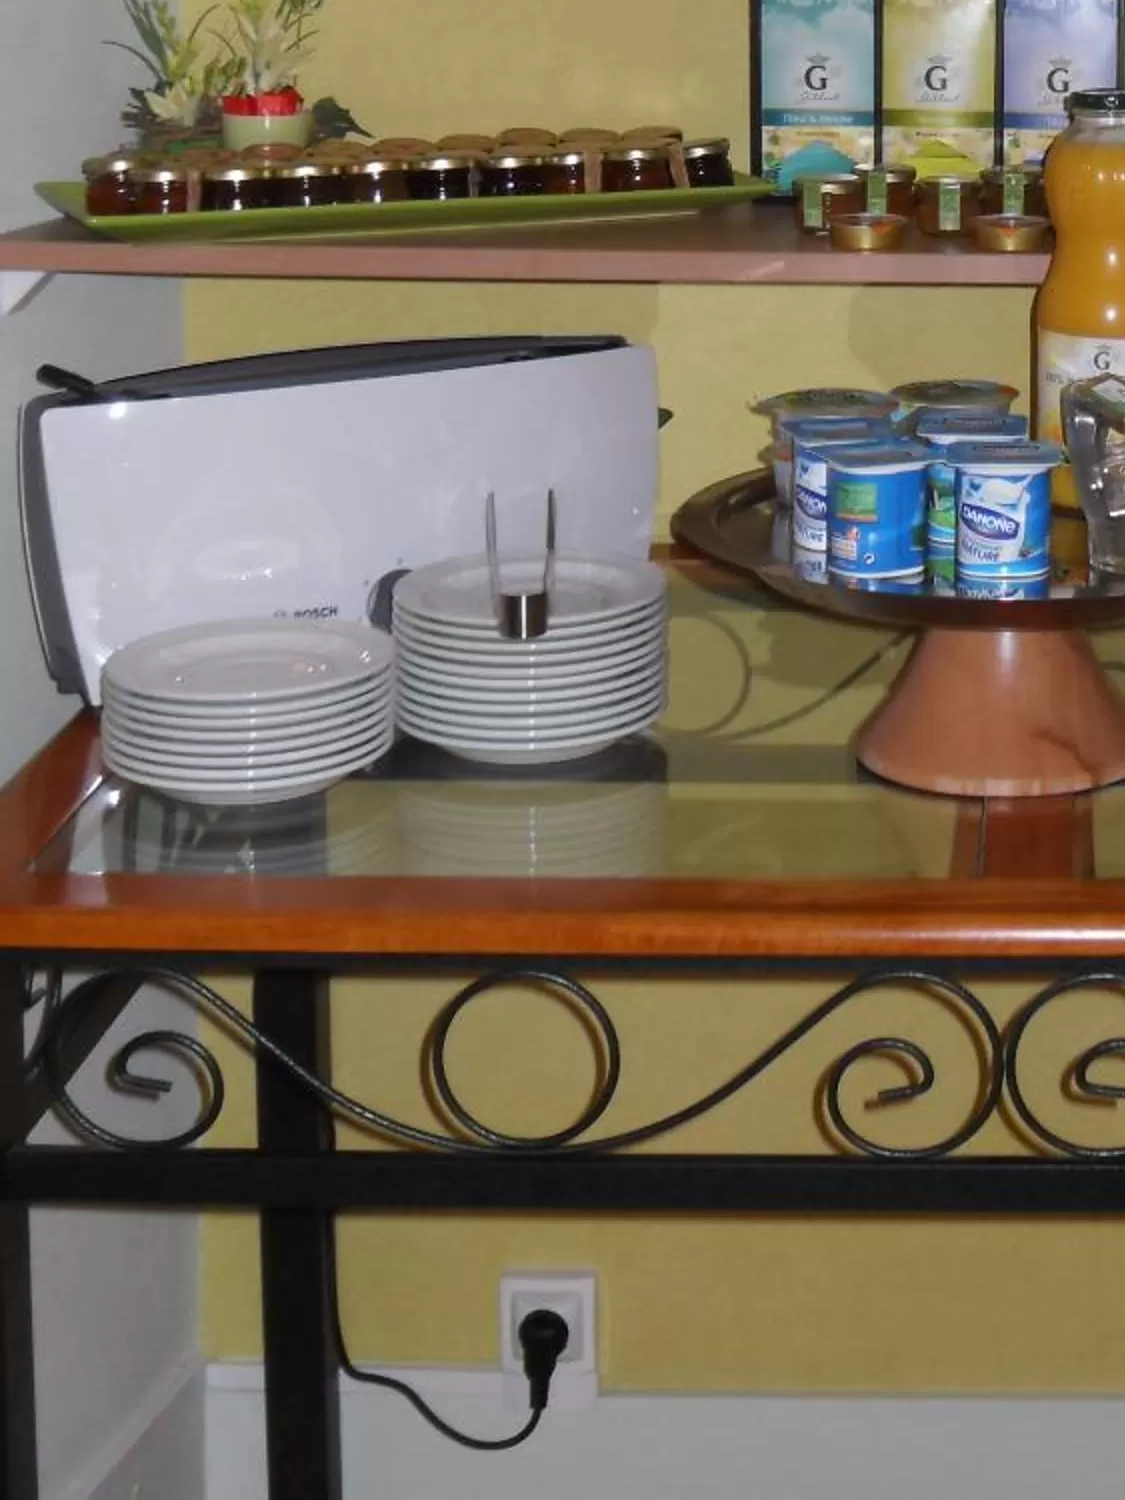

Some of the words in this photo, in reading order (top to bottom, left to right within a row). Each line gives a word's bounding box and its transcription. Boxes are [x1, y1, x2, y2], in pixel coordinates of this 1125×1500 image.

[803, 65, 829, 91] G
[923, 65, 948, 91] G
[1046, 67, 1070, 93] G
[1093, 351, 1111, 371] G
